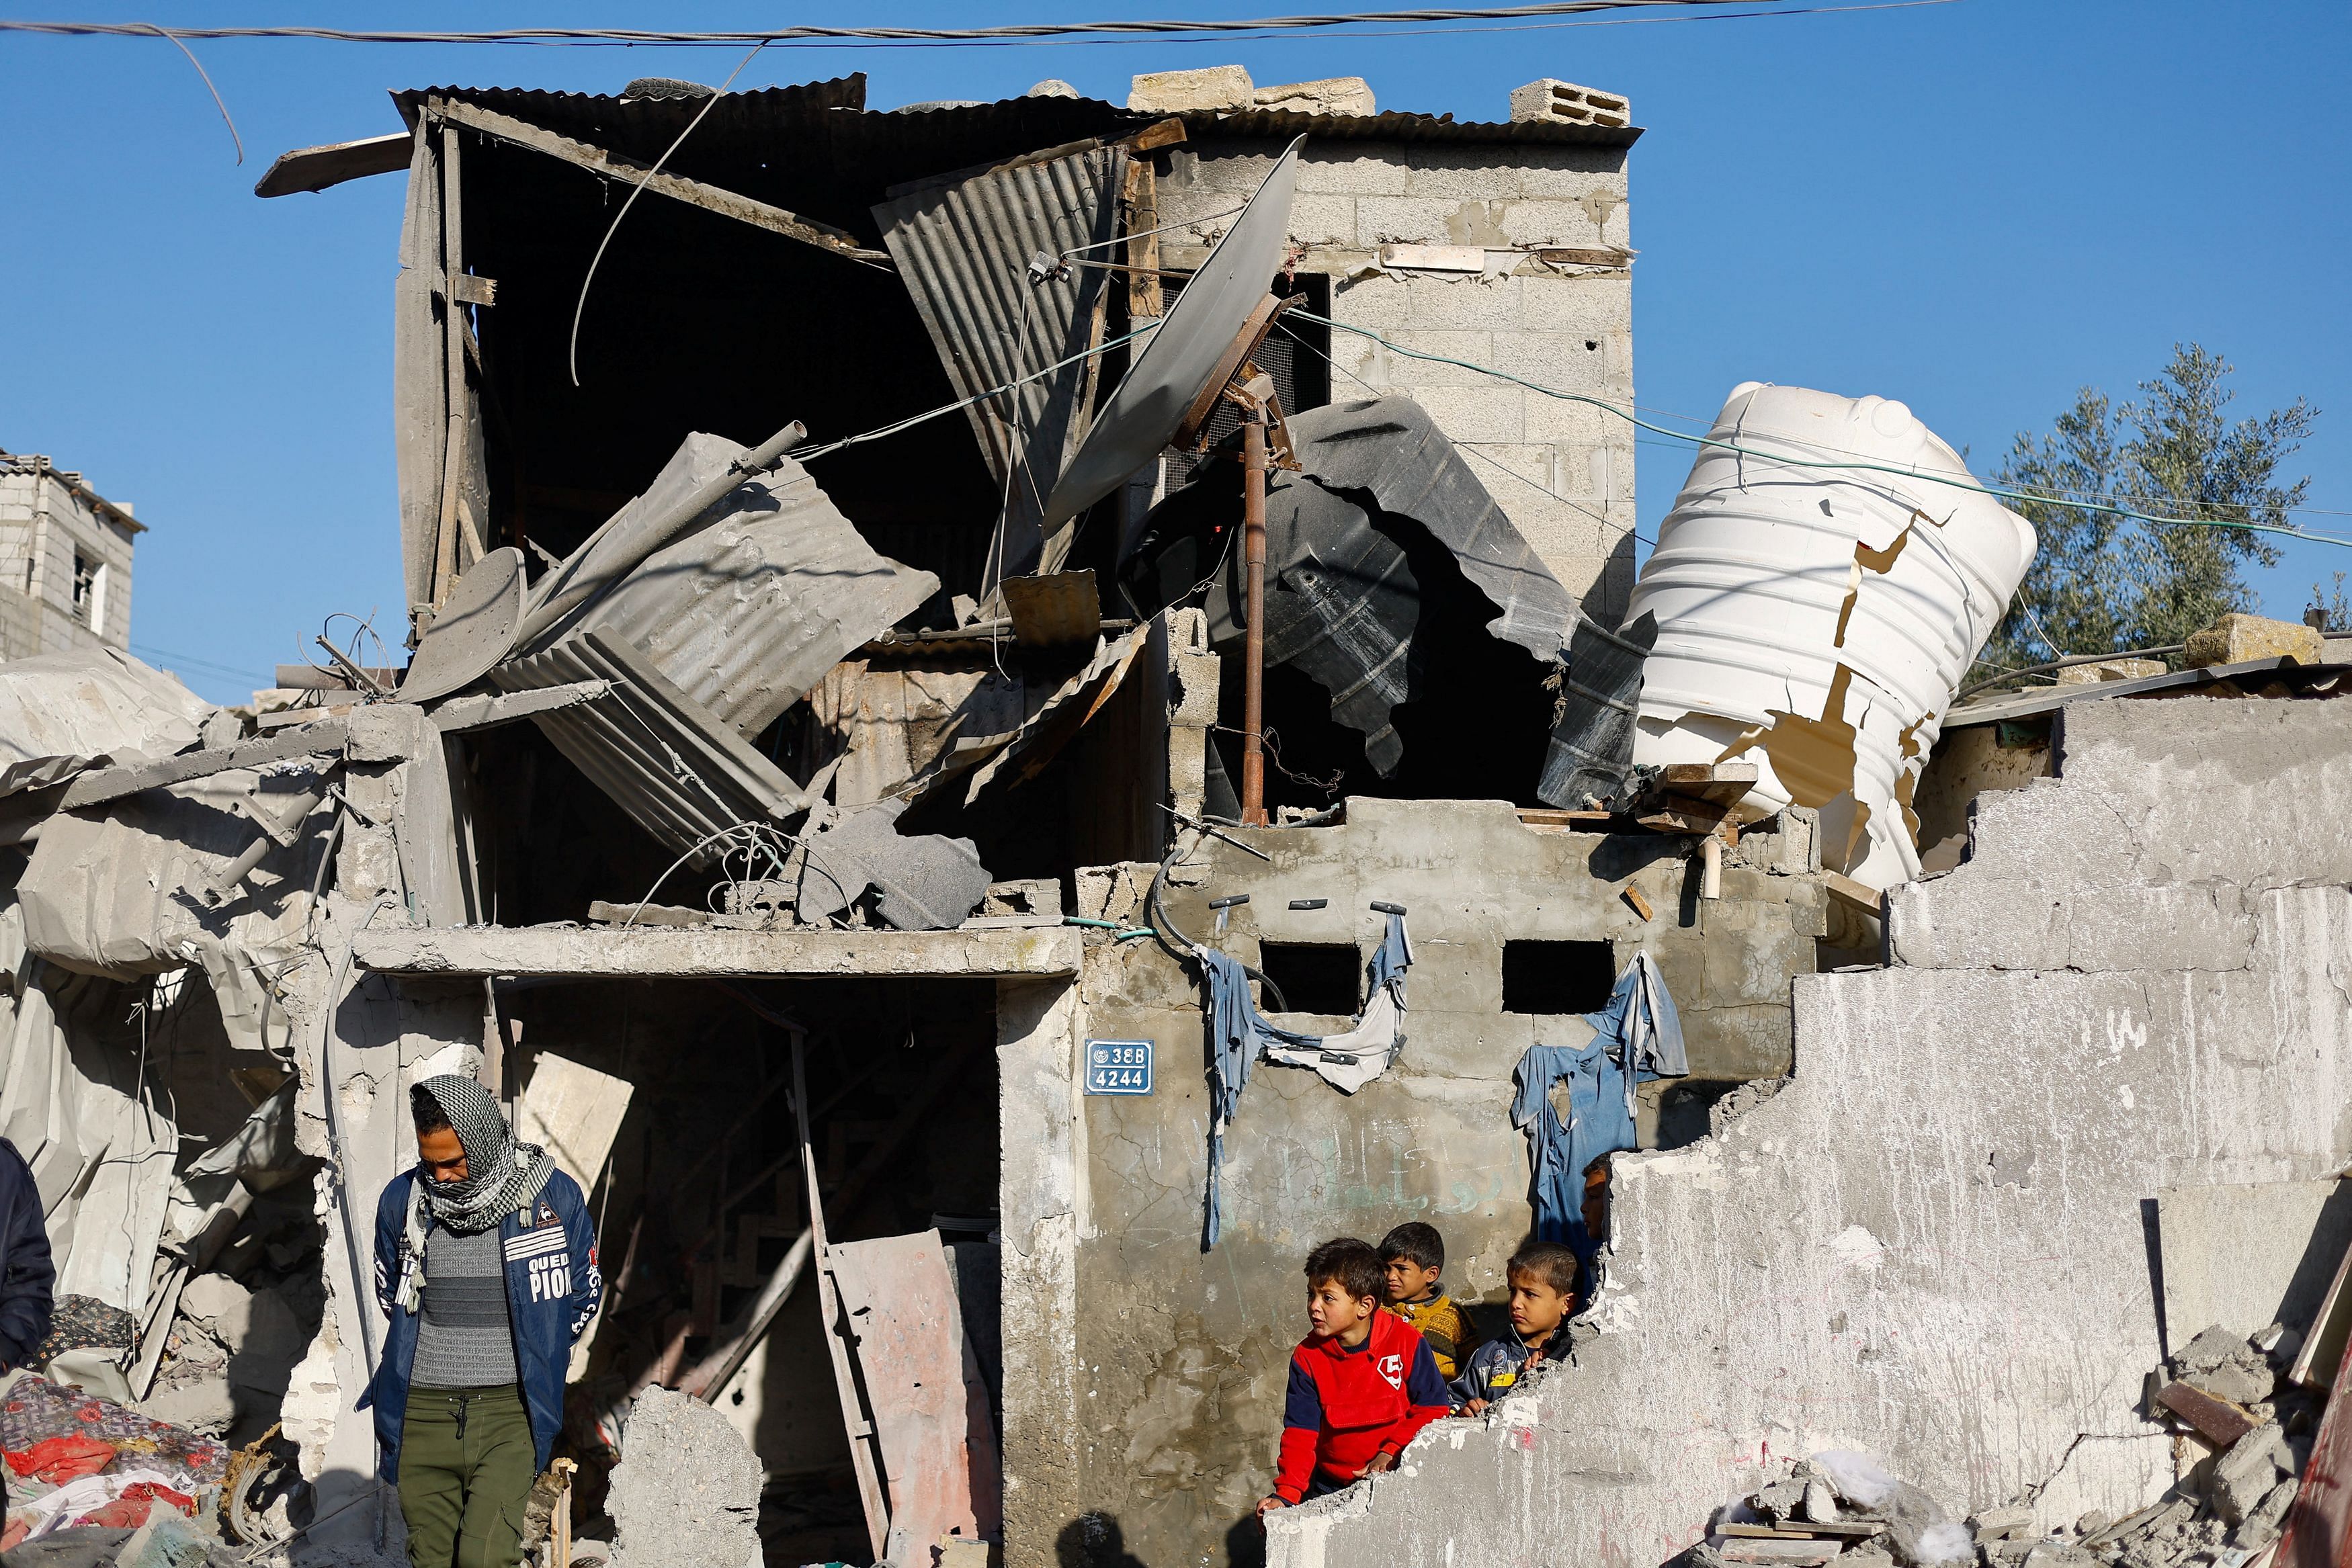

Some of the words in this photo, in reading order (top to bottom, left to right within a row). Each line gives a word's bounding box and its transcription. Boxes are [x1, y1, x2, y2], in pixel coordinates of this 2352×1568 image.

[1112, 1048, 1144, 1063] 38B
[1096, 1070, 1142, 1086] 4244
[1386, 1355, 1401, 1385] 5
